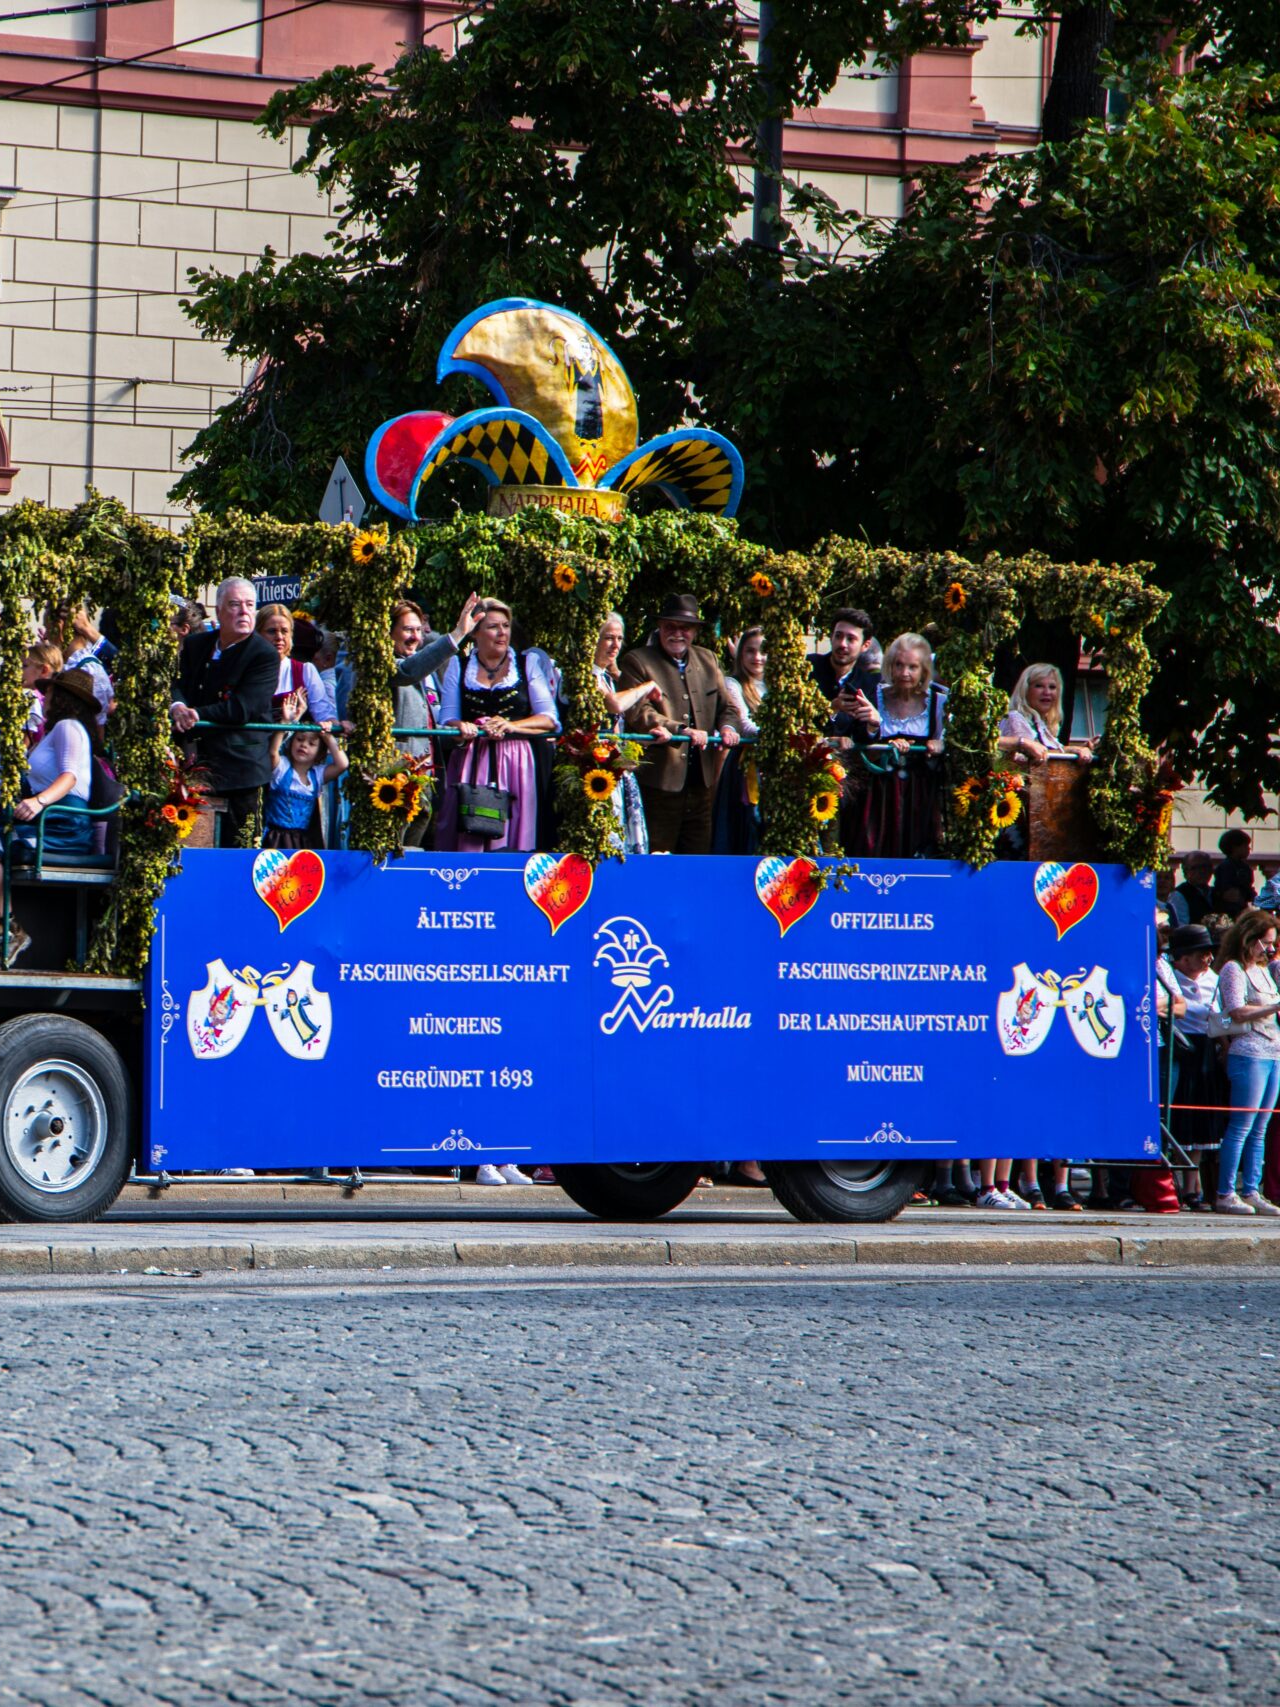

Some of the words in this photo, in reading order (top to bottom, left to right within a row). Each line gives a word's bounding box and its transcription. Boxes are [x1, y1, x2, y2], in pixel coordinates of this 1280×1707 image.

[416, 907, 496, 930] ÄLTESTE
[830, 912, 935, 931] OFFIZIELLES
[339, 963, 571, 983] FASCHINGSGESELLSCHAFT
[778, 962, 988, 982] FASCHINGSPRINZENPAAR
[599, 981, 753, 1036] Narrhalla
[408, 1012, 503, 1036] MÜNCHENS
[778, 1013, 812, 1032] DER
[815, 1013, 990, 1032] LANDESHAUPTSTADT
[377, 1066, 485, 1089] GEGRÜNDET
[489, 1066, 534, 1089] 1893
[846, 1060, 924, 1083] MÜNCHEN
